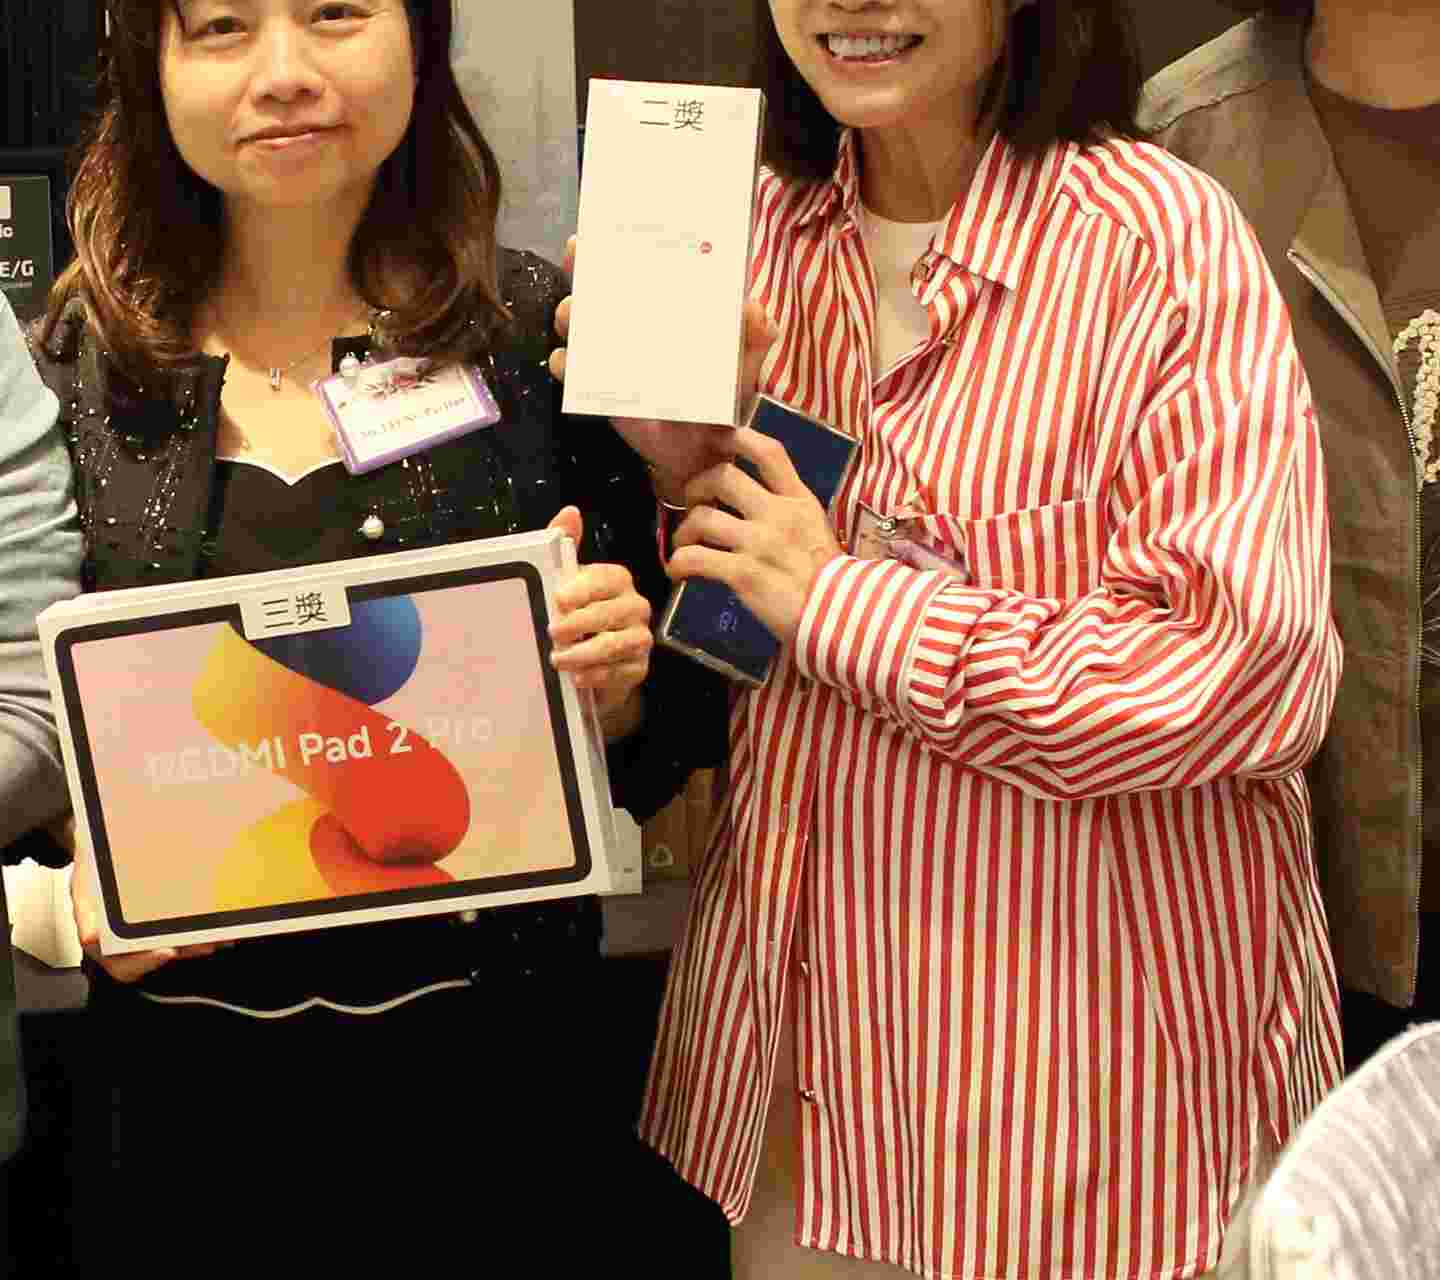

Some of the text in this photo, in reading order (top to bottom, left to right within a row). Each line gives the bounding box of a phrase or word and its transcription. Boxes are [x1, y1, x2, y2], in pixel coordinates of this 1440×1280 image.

[639, 99, 705, 131] 二獎
[262, 591, 329, 628] 三獎
[298, 724, 372, 766] Pad
[385, 721, 413, 754] 2
[423, 713, 495, 749] Pro
